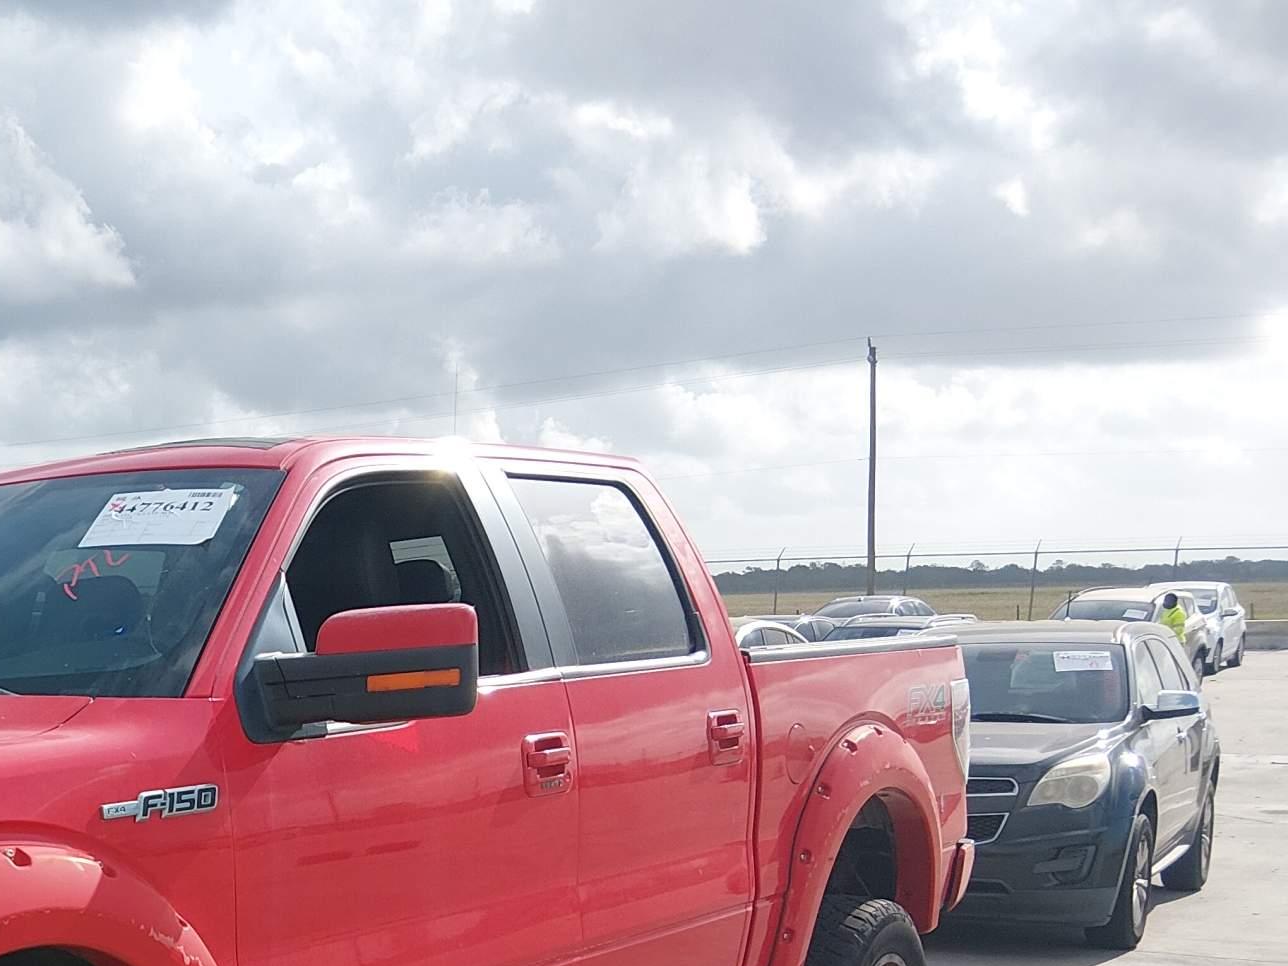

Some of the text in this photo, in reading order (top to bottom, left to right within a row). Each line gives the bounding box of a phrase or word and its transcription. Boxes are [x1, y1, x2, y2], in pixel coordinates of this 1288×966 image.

[109, 500, 215, 514] 44776412
[907, 683, 951, 716] FX4
[138, 784, 218, 820] F-150
